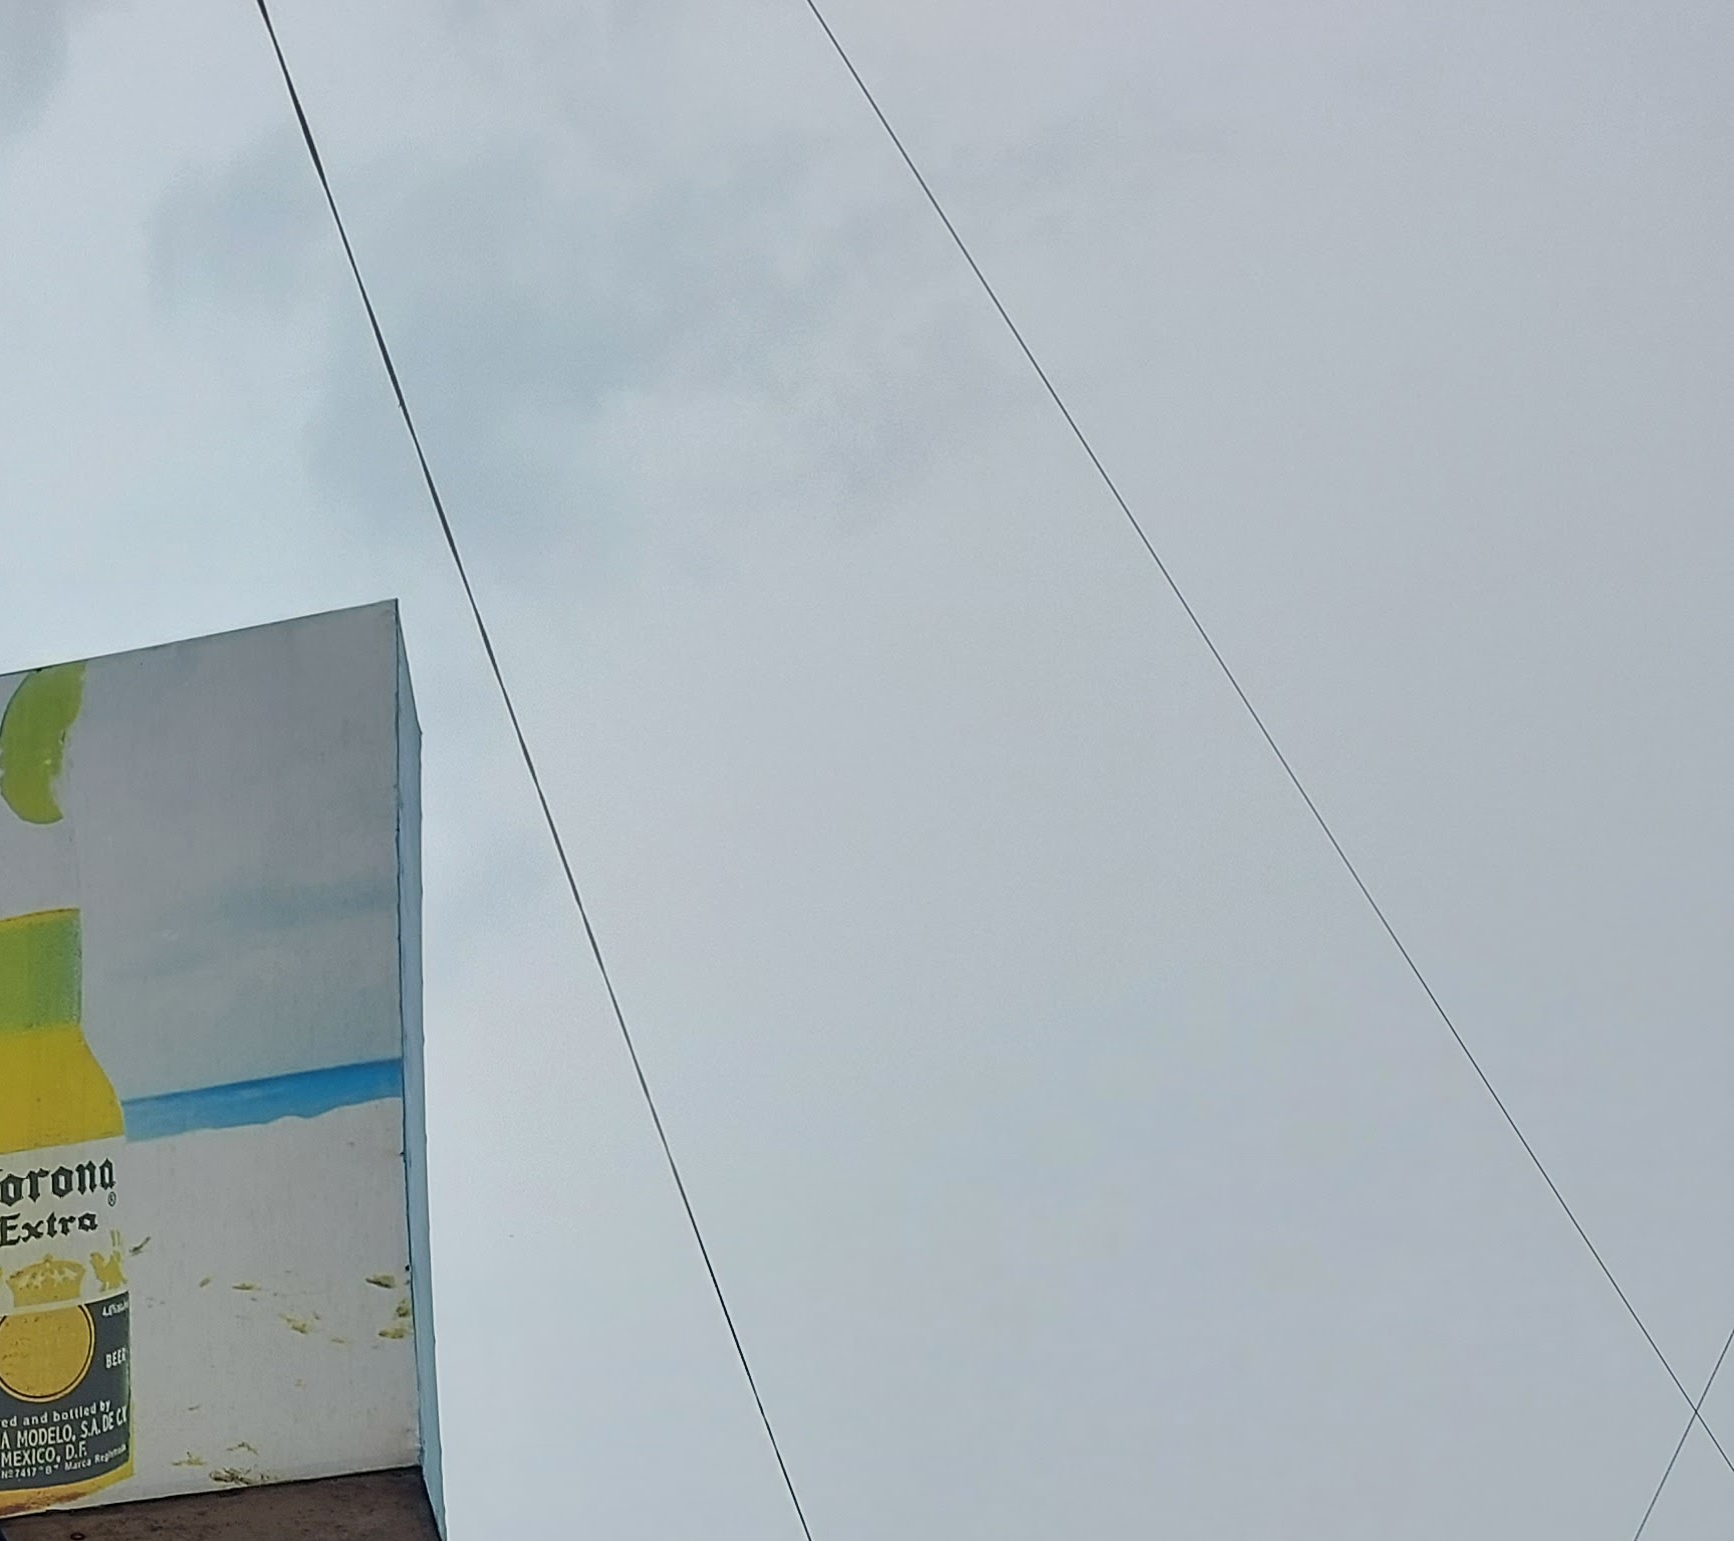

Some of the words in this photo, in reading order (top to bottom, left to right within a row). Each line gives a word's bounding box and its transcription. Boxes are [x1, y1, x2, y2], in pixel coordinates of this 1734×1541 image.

[23, 1411, 48, 1427] and
[52, 1402, 97, 1422] bottled
[99, 1399, 112, 1413] by
[102, 1413, 115, 1433] DE
